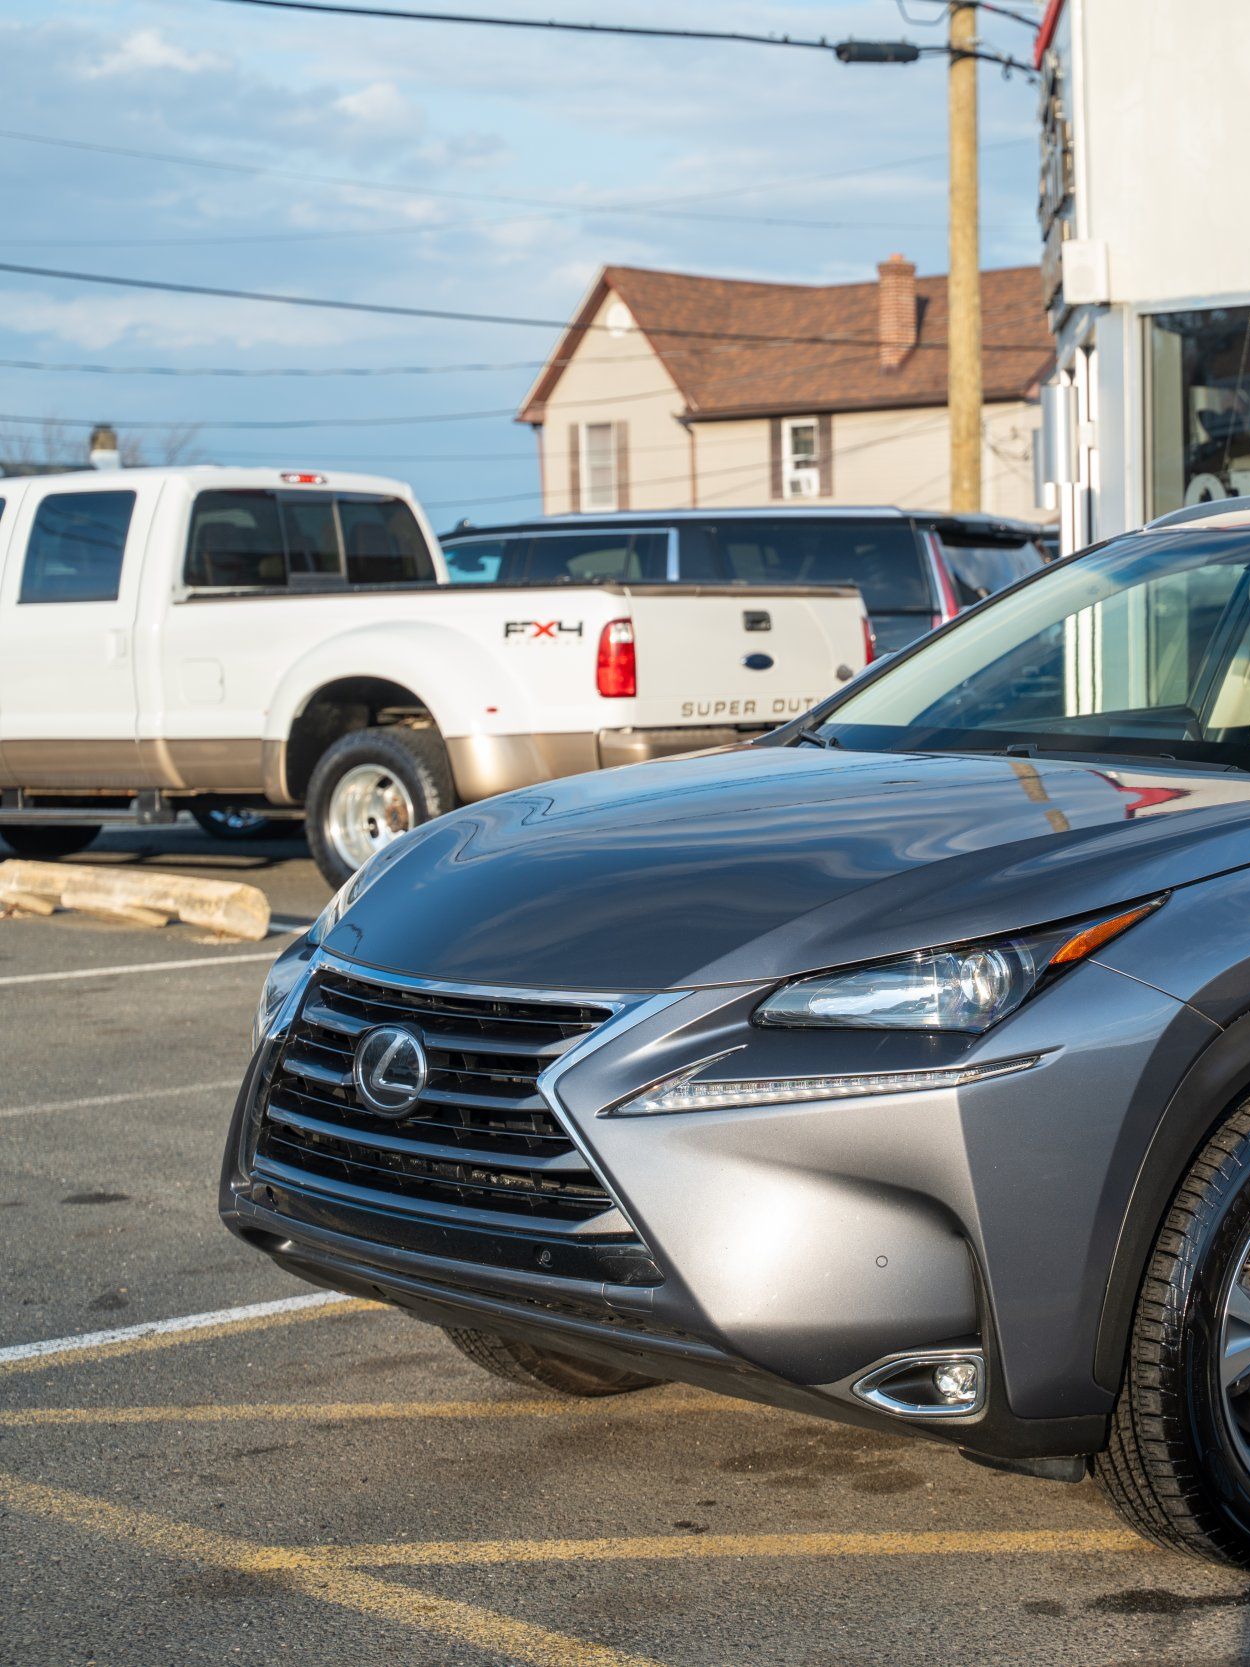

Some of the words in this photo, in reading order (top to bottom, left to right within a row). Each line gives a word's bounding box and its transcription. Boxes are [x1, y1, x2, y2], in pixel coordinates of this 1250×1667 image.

[505, 620, 582, 638] FX4
[681, 700, 756, 718] SUPER
[772, 697, 821, 714] DUT
